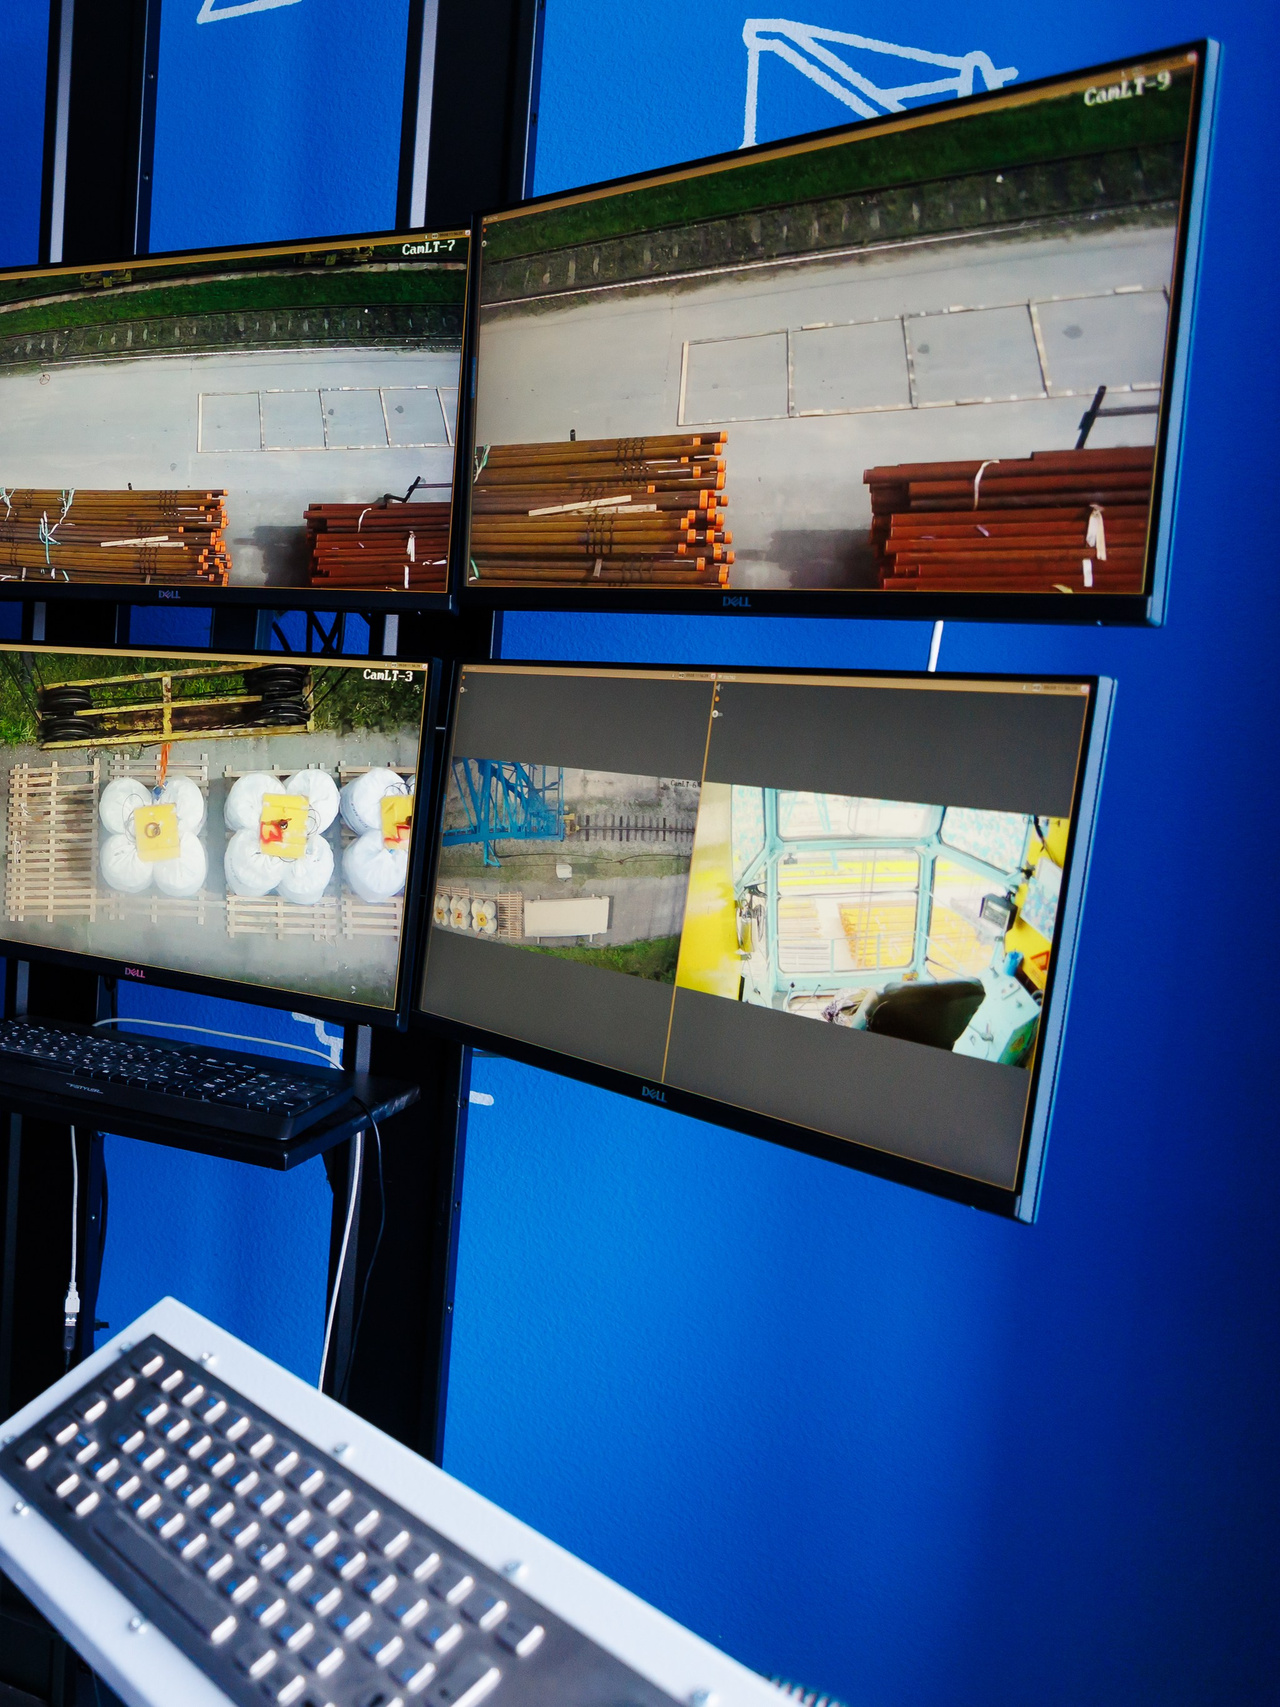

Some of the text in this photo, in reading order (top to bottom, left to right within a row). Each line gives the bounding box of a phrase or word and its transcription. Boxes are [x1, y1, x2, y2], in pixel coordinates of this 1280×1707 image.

[1084, 69, 1172, 107] CamLT-9
[402, 239, 456, 256] CamLT-7
[158, 590, 181, 599] DELL
[722, 596, 752, 607] DELL
[363, 668, 413, 682] CamLT-3
[124, 967, 146, 979] DELL
[641, 1085, 668, 1104] DELL
